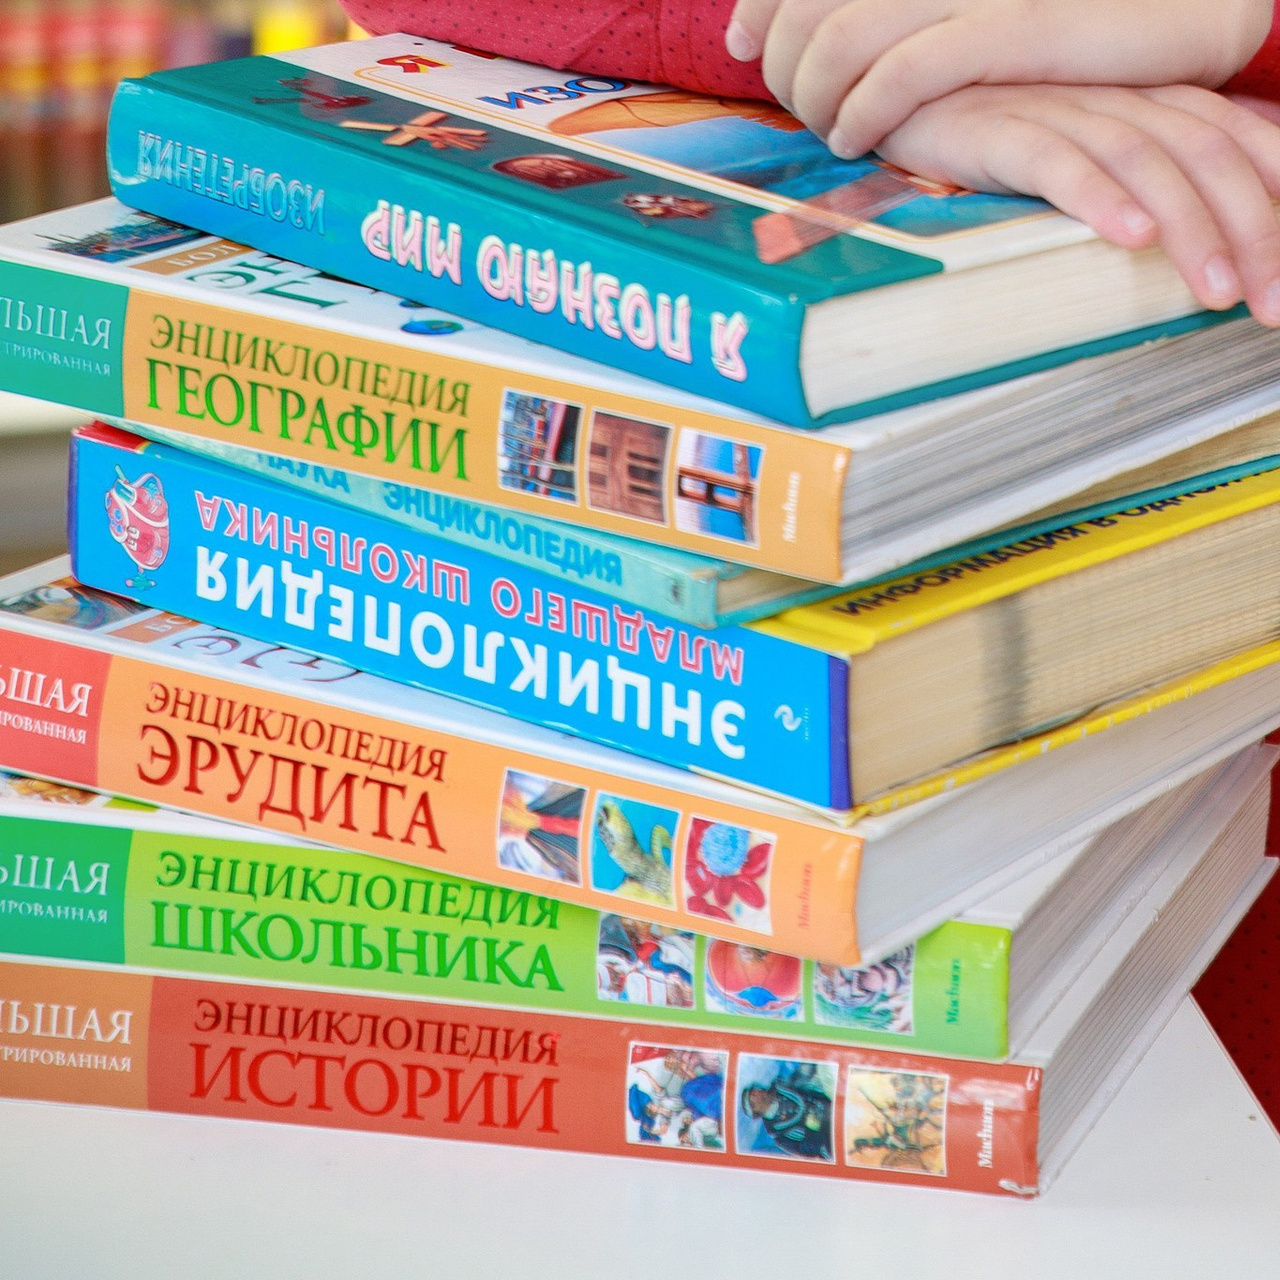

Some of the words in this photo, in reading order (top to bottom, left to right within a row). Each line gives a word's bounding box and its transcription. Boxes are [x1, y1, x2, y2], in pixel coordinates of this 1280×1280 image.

[137, 130, 325, 236] ИЗОБРЕТЕНИЯ
[360, 199, 464, 286] МИР
[476, 235, 692, 364] ПОЗНАЮ
[711, 312, 748, 383] Я
[151, 314, 471, 418] ЭНЦИКЛОПЕДИЯ
[144, 357, 471, 483] ГЕОГРАФИИ
[193, 489, 471, 605] ШКОЛЬНИКА
[383, 481, 624, 587] ЭНЦИКЛОПЕДИЯ
[832, 525, 1088, 616] ИНФОРМАЦИЯ
[195, 543, 746, 759] ЭНЦИКЛОПЕДИЯ
[490, 578, 744, 686] МЛАДШЕГО
[147, 681, 449, 784] ЭНЦИКЛОПЕДИЯ
[136, 724, 448, 854] ЭРУДИТА
[155, 849, 560, 930] ЭНЦИКЛОПЕДИЯ
[150, 899, 565, 992] ШКОЛЬНИКА
[0, 999, 134, 1045] ЬШАЯ
[193, 998, 560, 1068] ЭНЦИКЛОПЕДИЯ
[189, 1042, 560, 1135] ИСТОРИИ
